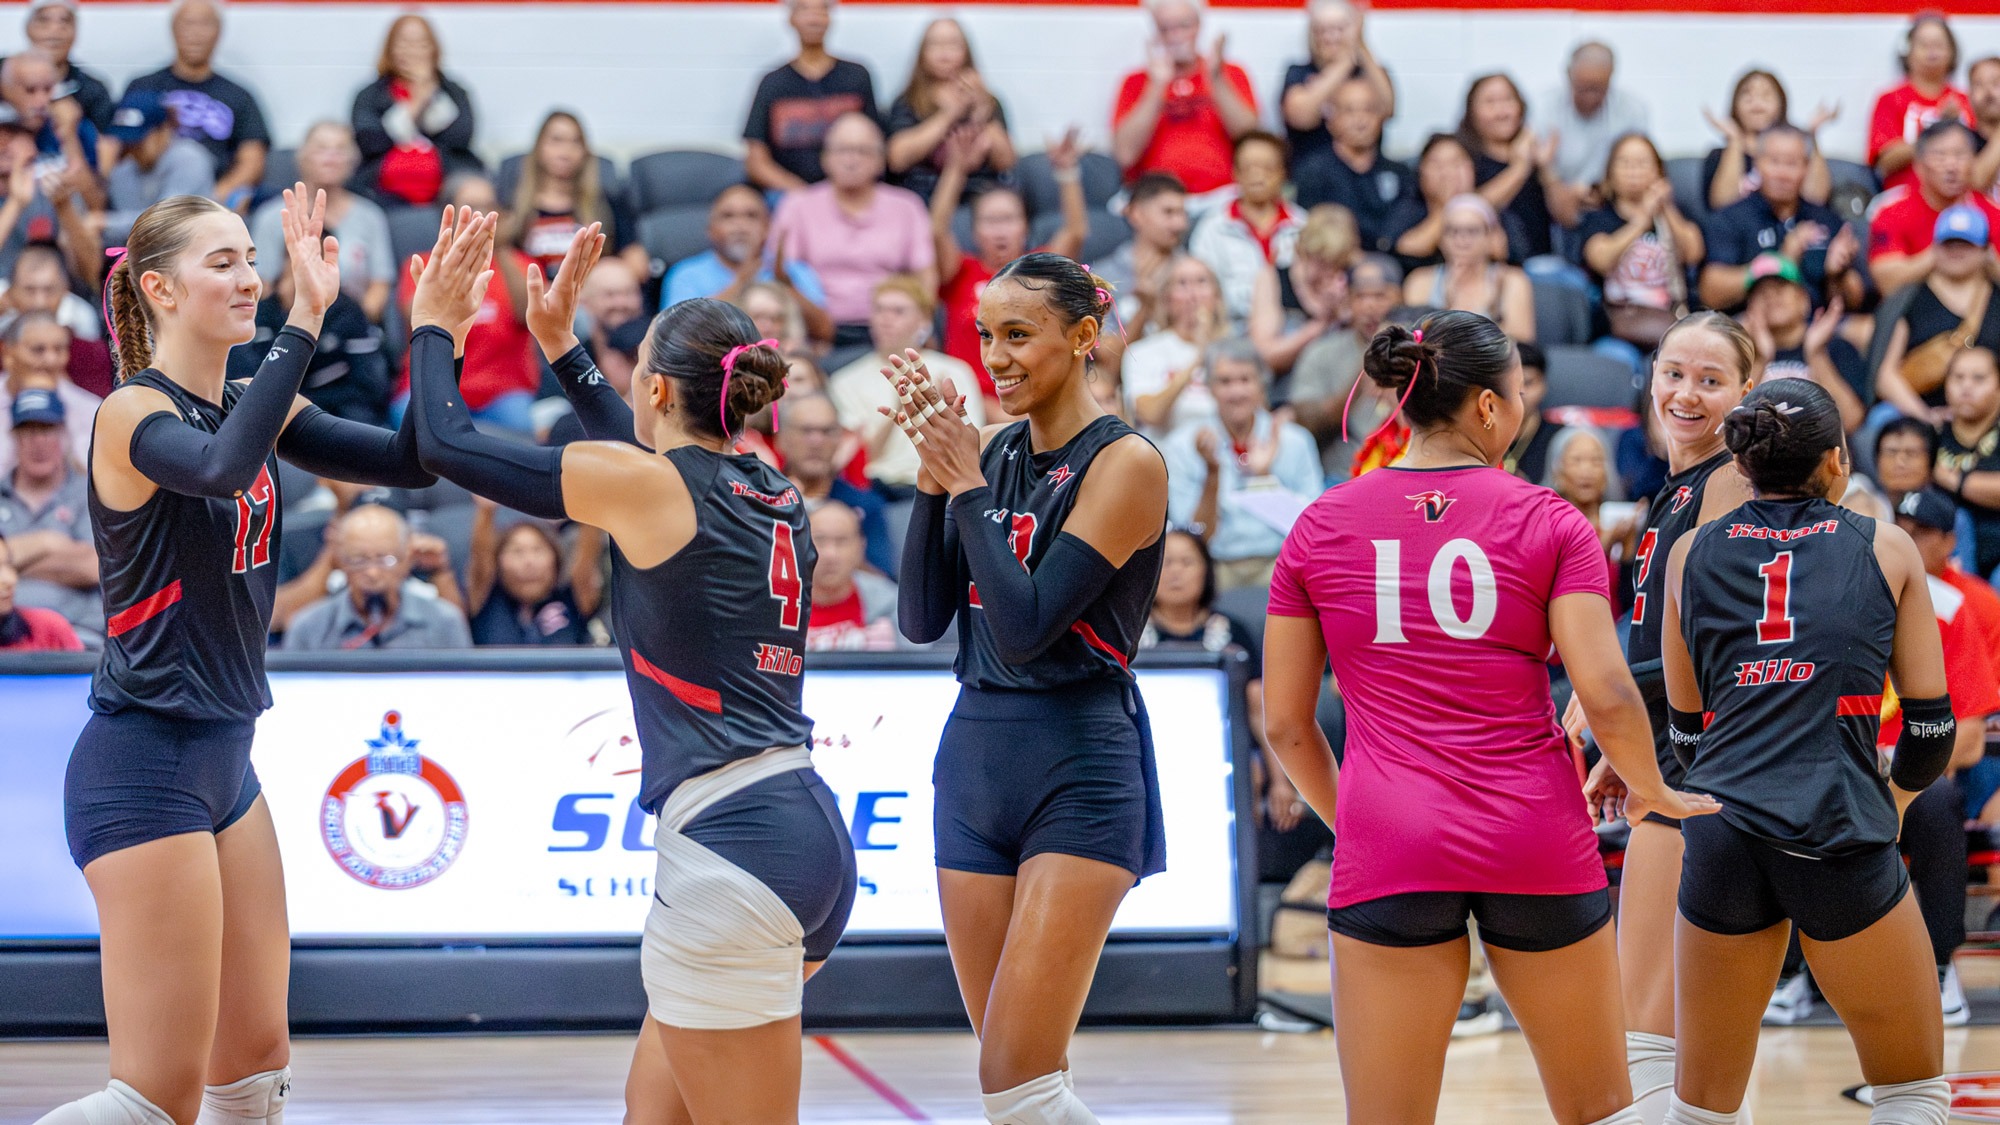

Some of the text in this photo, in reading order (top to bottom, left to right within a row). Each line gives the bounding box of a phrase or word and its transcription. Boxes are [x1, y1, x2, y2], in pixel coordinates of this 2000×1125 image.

[231, 462, 275, 574] 17
[768, 518, 803, 631] 4
[1370, 537, 1498, 644] 10
[1756, 550, 1794, 645] 1
